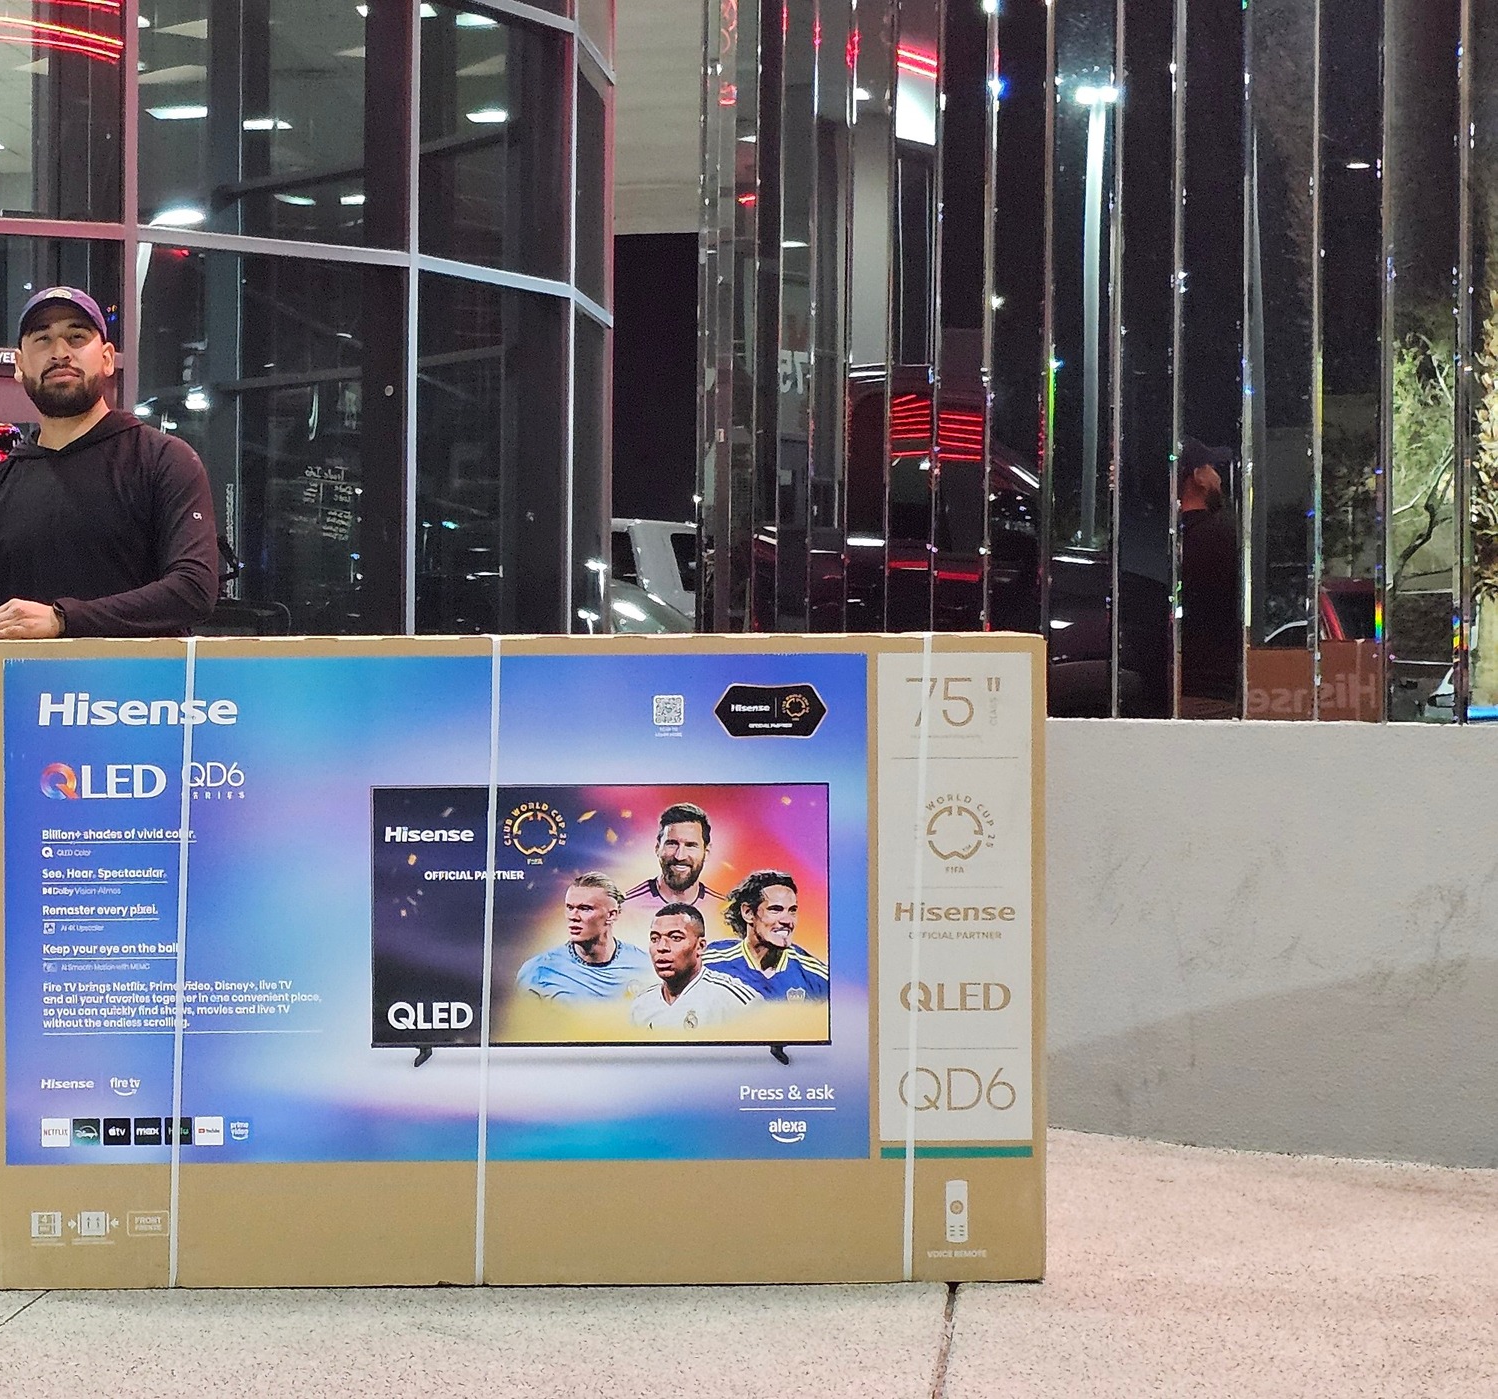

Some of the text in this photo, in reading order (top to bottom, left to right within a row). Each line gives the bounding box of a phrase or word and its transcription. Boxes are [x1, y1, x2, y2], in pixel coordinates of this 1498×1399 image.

[38, 692, 238, 726] Hisense
[730, 704, 770, 712] Hisense
[40, 762, 167, 800] QLED
[182, 762, 245, 788] QD6
[926, 794, 972, 811] WORLD
[551, 809, 566, 829] CUP
[976, 803, 995, 826] CUP
[42, 828, 197, 840] Billion+ shades of vivid colr.
[385, 826, 475, 843] Hisense
[67, 868, 96, 879] Hear.
[97, 867, 167, 880] Spectacular.
[424, 870, 525, 881] OFFICIAL PATNER
[53, 887, 74, 897] Dolby
[43, 904, 159, 917] Remaster every pixel.
[894, 902, 1016, 921] Hisense
[956, 931, 1002, 939] PARTNER
[43, 944, 70, 956] Keep
[73, 945, 98, 956] your
[100, 945, 119, 957] eye
[122, 945, 137, 953] on
[139, 943, 156, 953] the
[43, 982, 62, 991] Fire
[64, 982, 77, 991] TV
[79, 982, 111, 993] brings
[113, 982, 148, 992] Netflix,
[260, 980, 277, 989] live
[279, 980, 292, 989] TV
[43, 994, 63, 1004] and
[66, 994, 77, 1003] all
[80, 996, 104, 1006] your
[105, 994, 150, 1004] favorites
[199, 993, 208, 1002] in
[231, 993, 290, 1003] convenient
[291, 992, 322, 1003] place,
[900, 981, 1012, 1012] QLED
[43, 1007, 55, 1016] so
[57, 1008, 76, 1018] you
[78, 1008, 97, 1016] can
[100, 1006, 136, 1018] quickly
[139, 1005, 158, 1015] find
[197, 1005, 233, 1015] movies
[235, 1005, 255, 1014] and
[257, 1004, 275, 1014] live
[277, 1004, 290, 1013] TV
[387, 1001, 473, 1030] QLED
[43, 1016, 190, 1028] without the endless scrollig.
[41, 1079, 95, 1089] Hisense
[110, 1077, 141, 1089] fire tv
[898, 1067, 1017, 1112] QD6
[740, 1084, 835, 1100] Press & ask
[43, 1127, 68, 1136] NETFLIX
[136, 1127, 159, 1136] max
[768, 1118, 807, 1133] alexa
